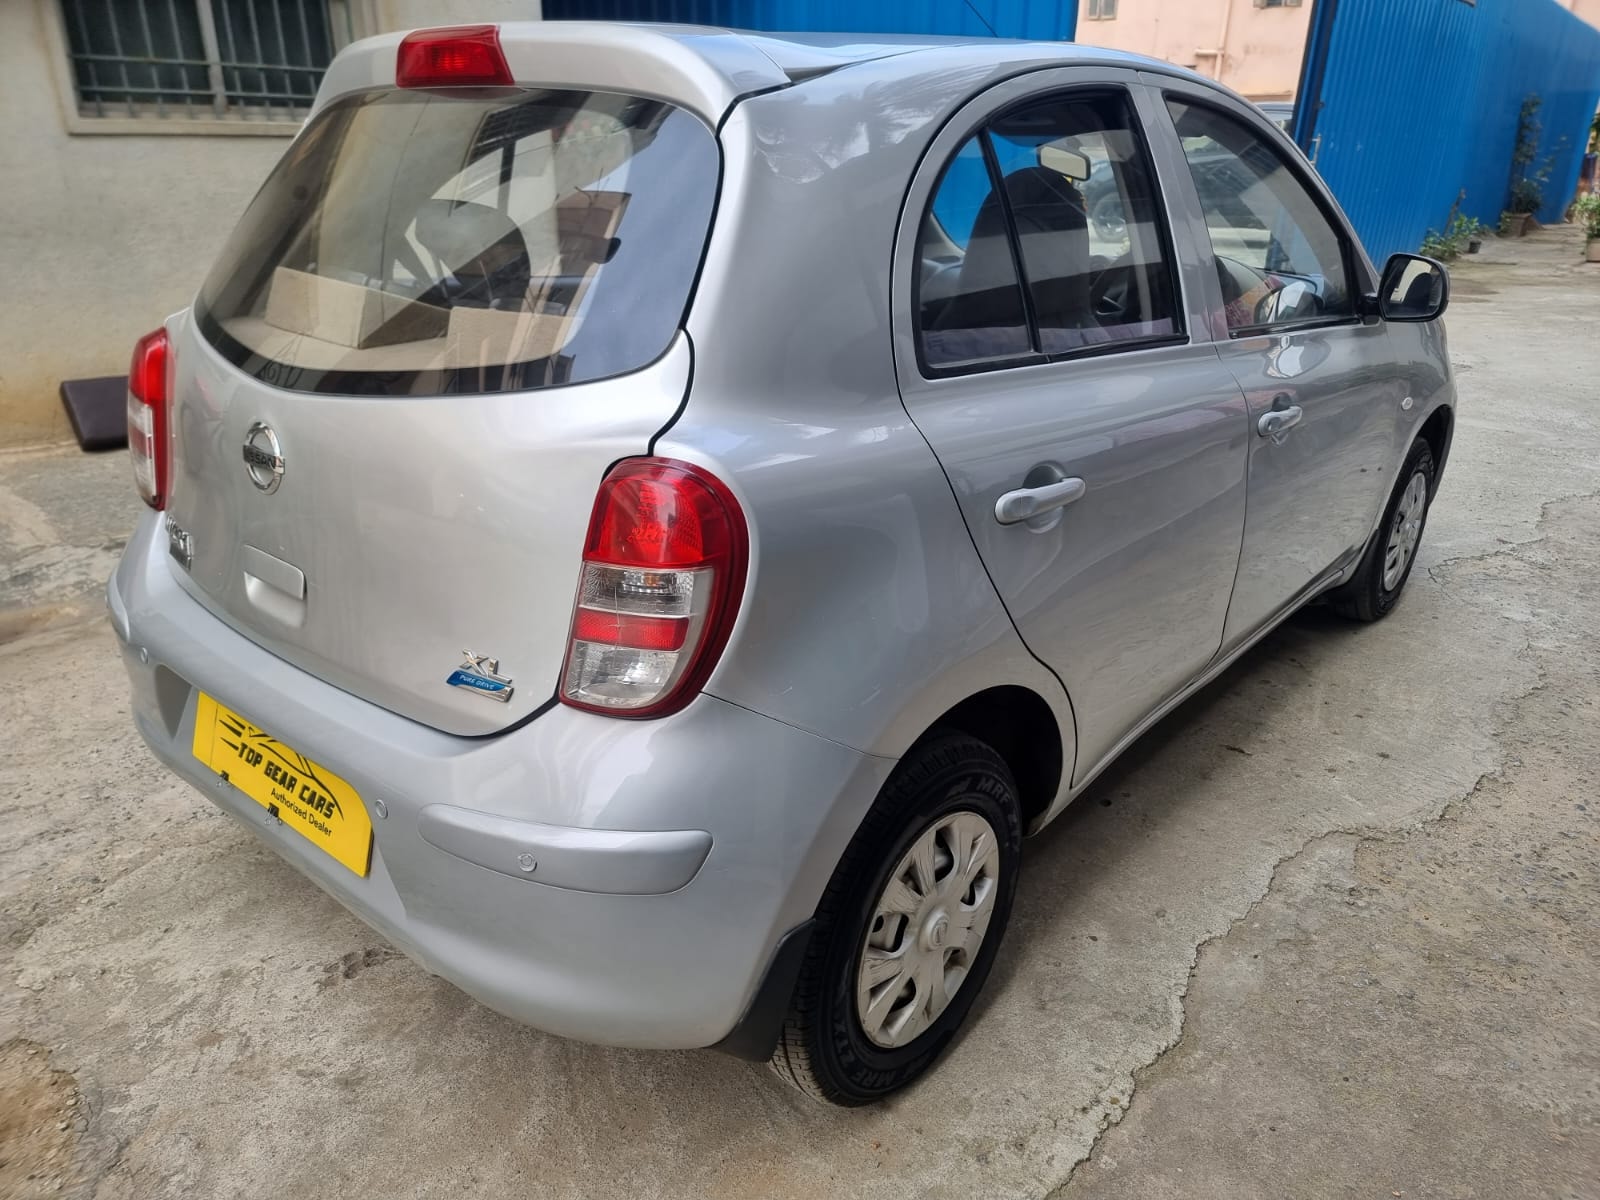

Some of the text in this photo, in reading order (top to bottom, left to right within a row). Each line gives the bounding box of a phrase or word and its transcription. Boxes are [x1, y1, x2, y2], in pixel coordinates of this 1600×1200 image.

[459, 648, 512, 684] XL
[238, 742, 336, 819] TOP GEAR CARS
[976, 777, 1010, 804] MRF
[270, 788, 333, 837] Authorized Dealer
